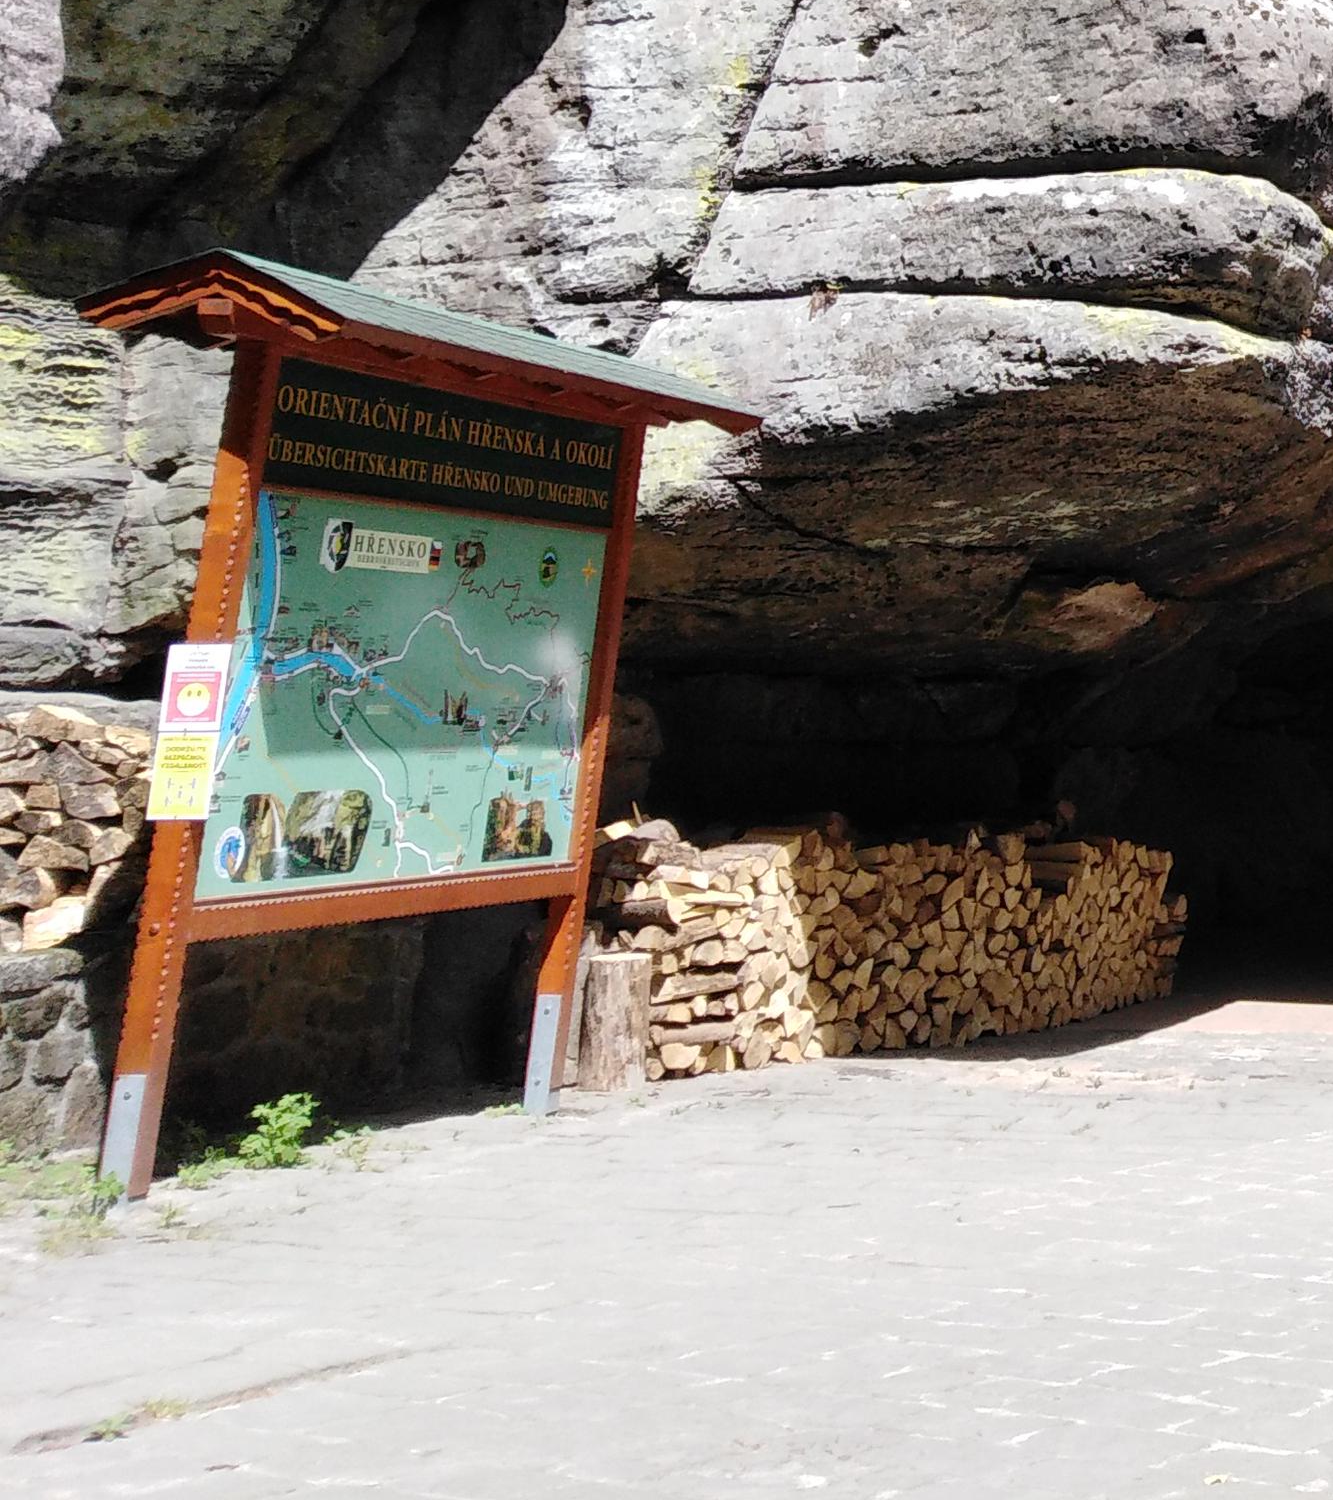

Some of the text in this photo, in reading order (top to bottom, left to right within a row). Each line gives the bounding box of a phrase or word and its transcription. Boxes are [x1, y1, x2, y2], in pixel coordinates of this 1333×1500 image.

[278, 385, 615, 470] ORIENTAČNÍ PLÁN HŘENSKA A OKOLÍ
[268, 433, 609, 510] ÜBERSICHTSKARTE HŘENSKO UND UMGEBUNG
[353, 533, 427, 559] HŘENSKO
